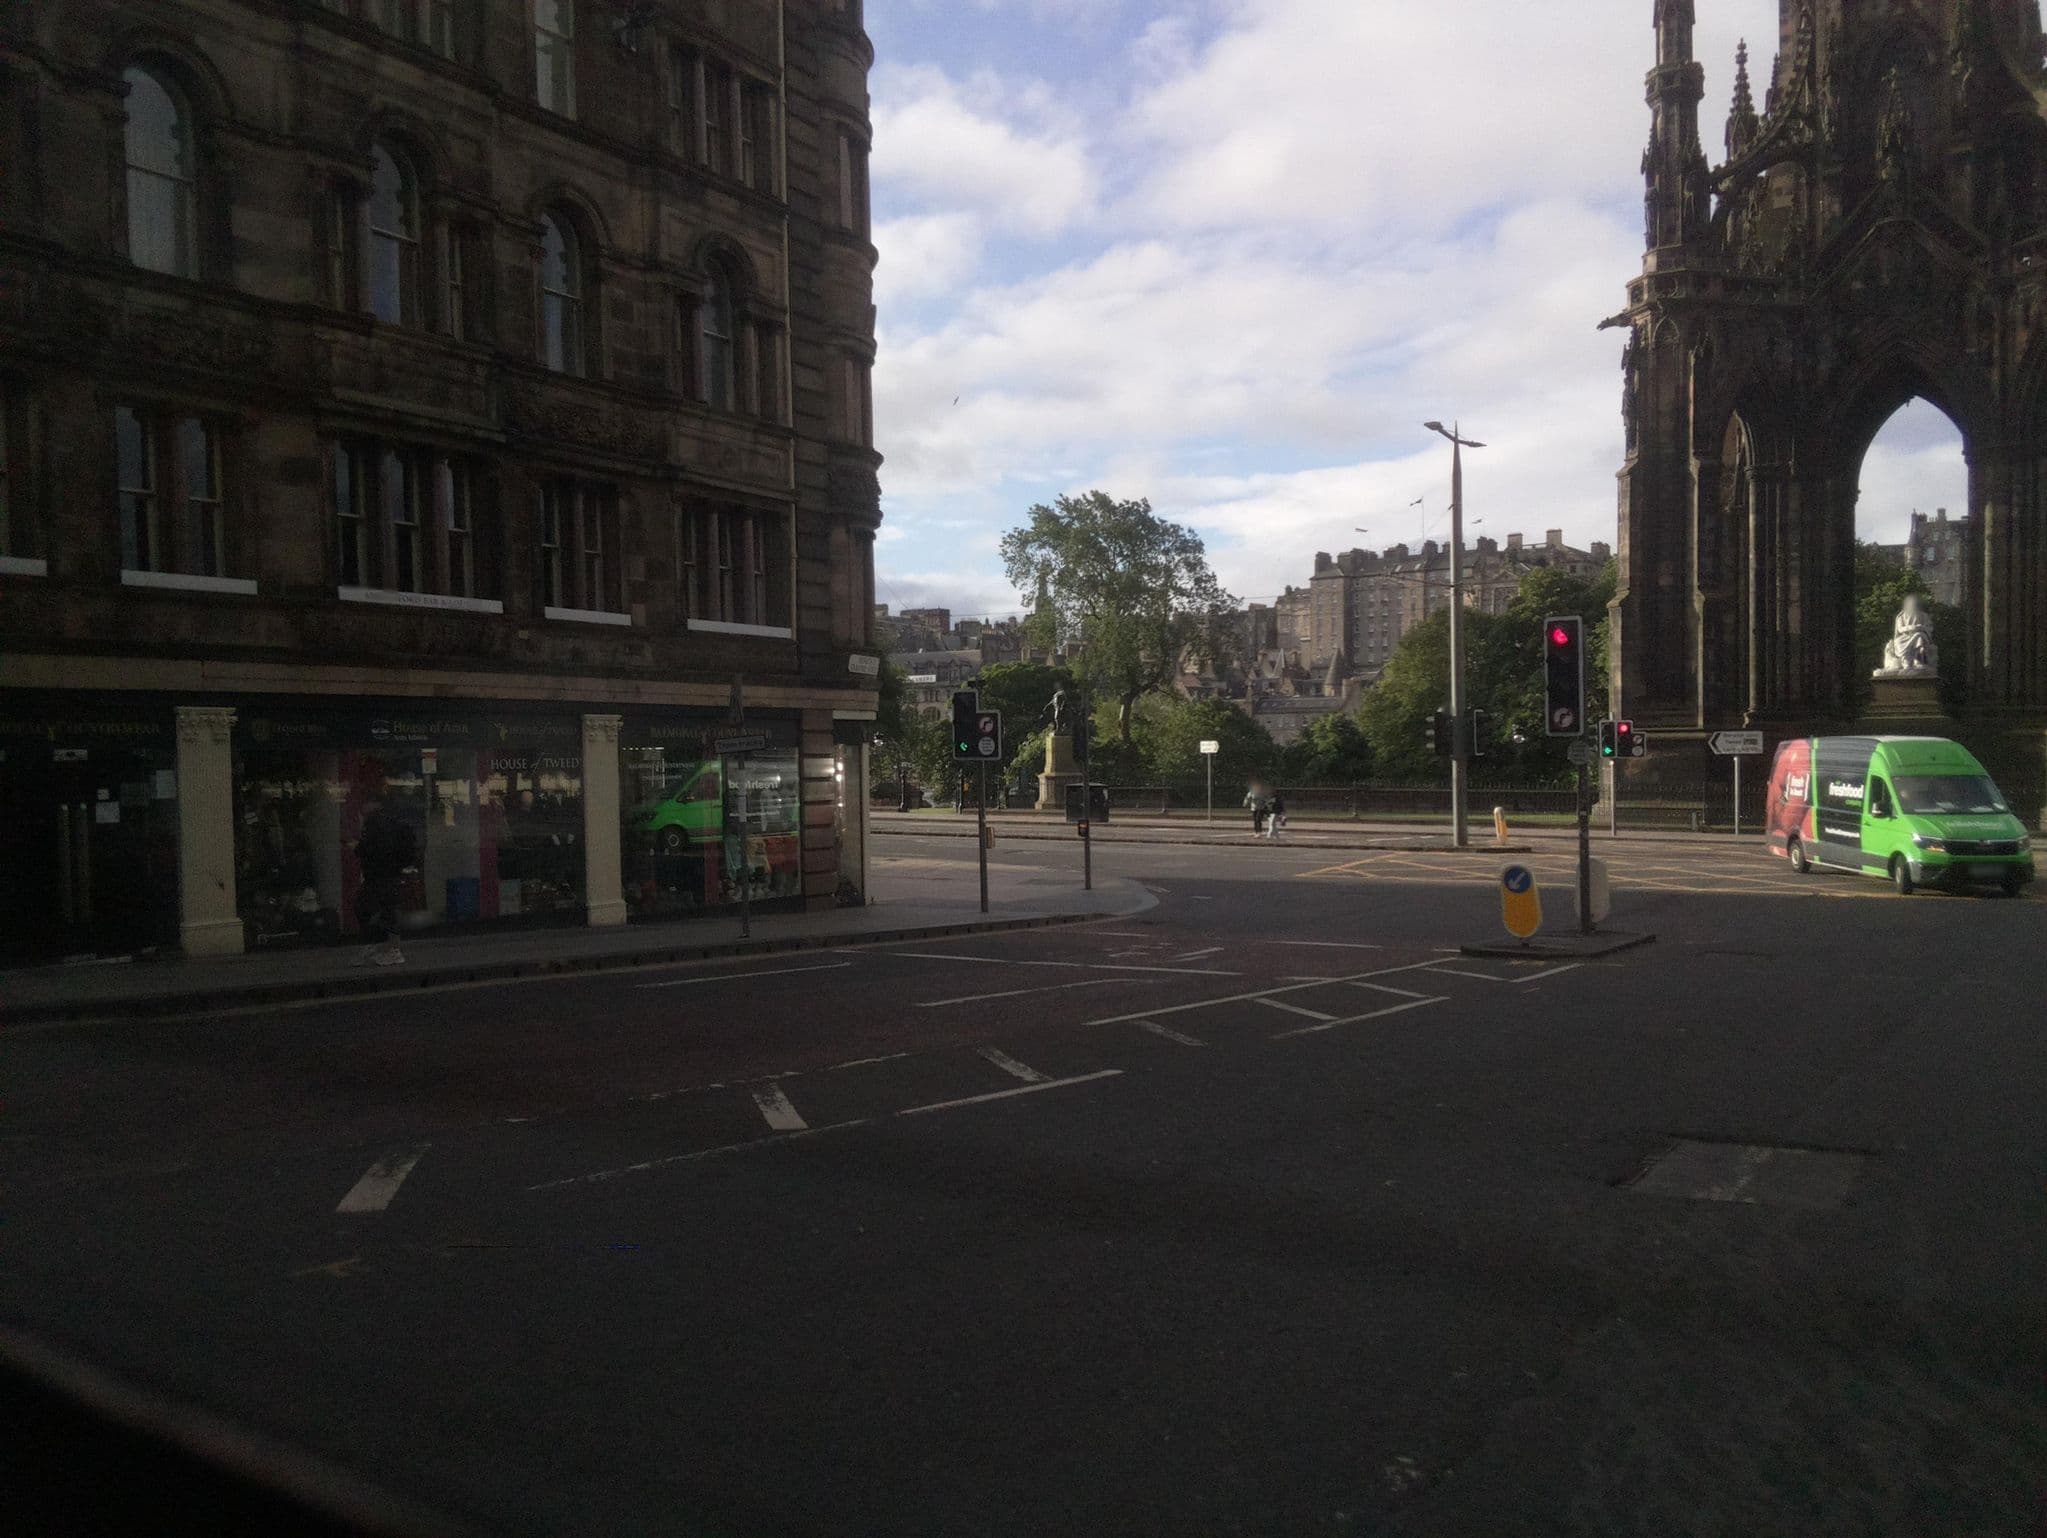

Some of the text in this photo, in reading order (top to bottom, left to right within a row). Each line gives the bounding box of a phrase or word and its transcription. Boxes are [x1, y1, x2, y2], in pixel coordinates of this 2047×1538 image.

[491, 759, 528, 770] HOUSE
[544, 758, 580, 768] TWEED
[1828, 782, 1864, 799] freshfood
